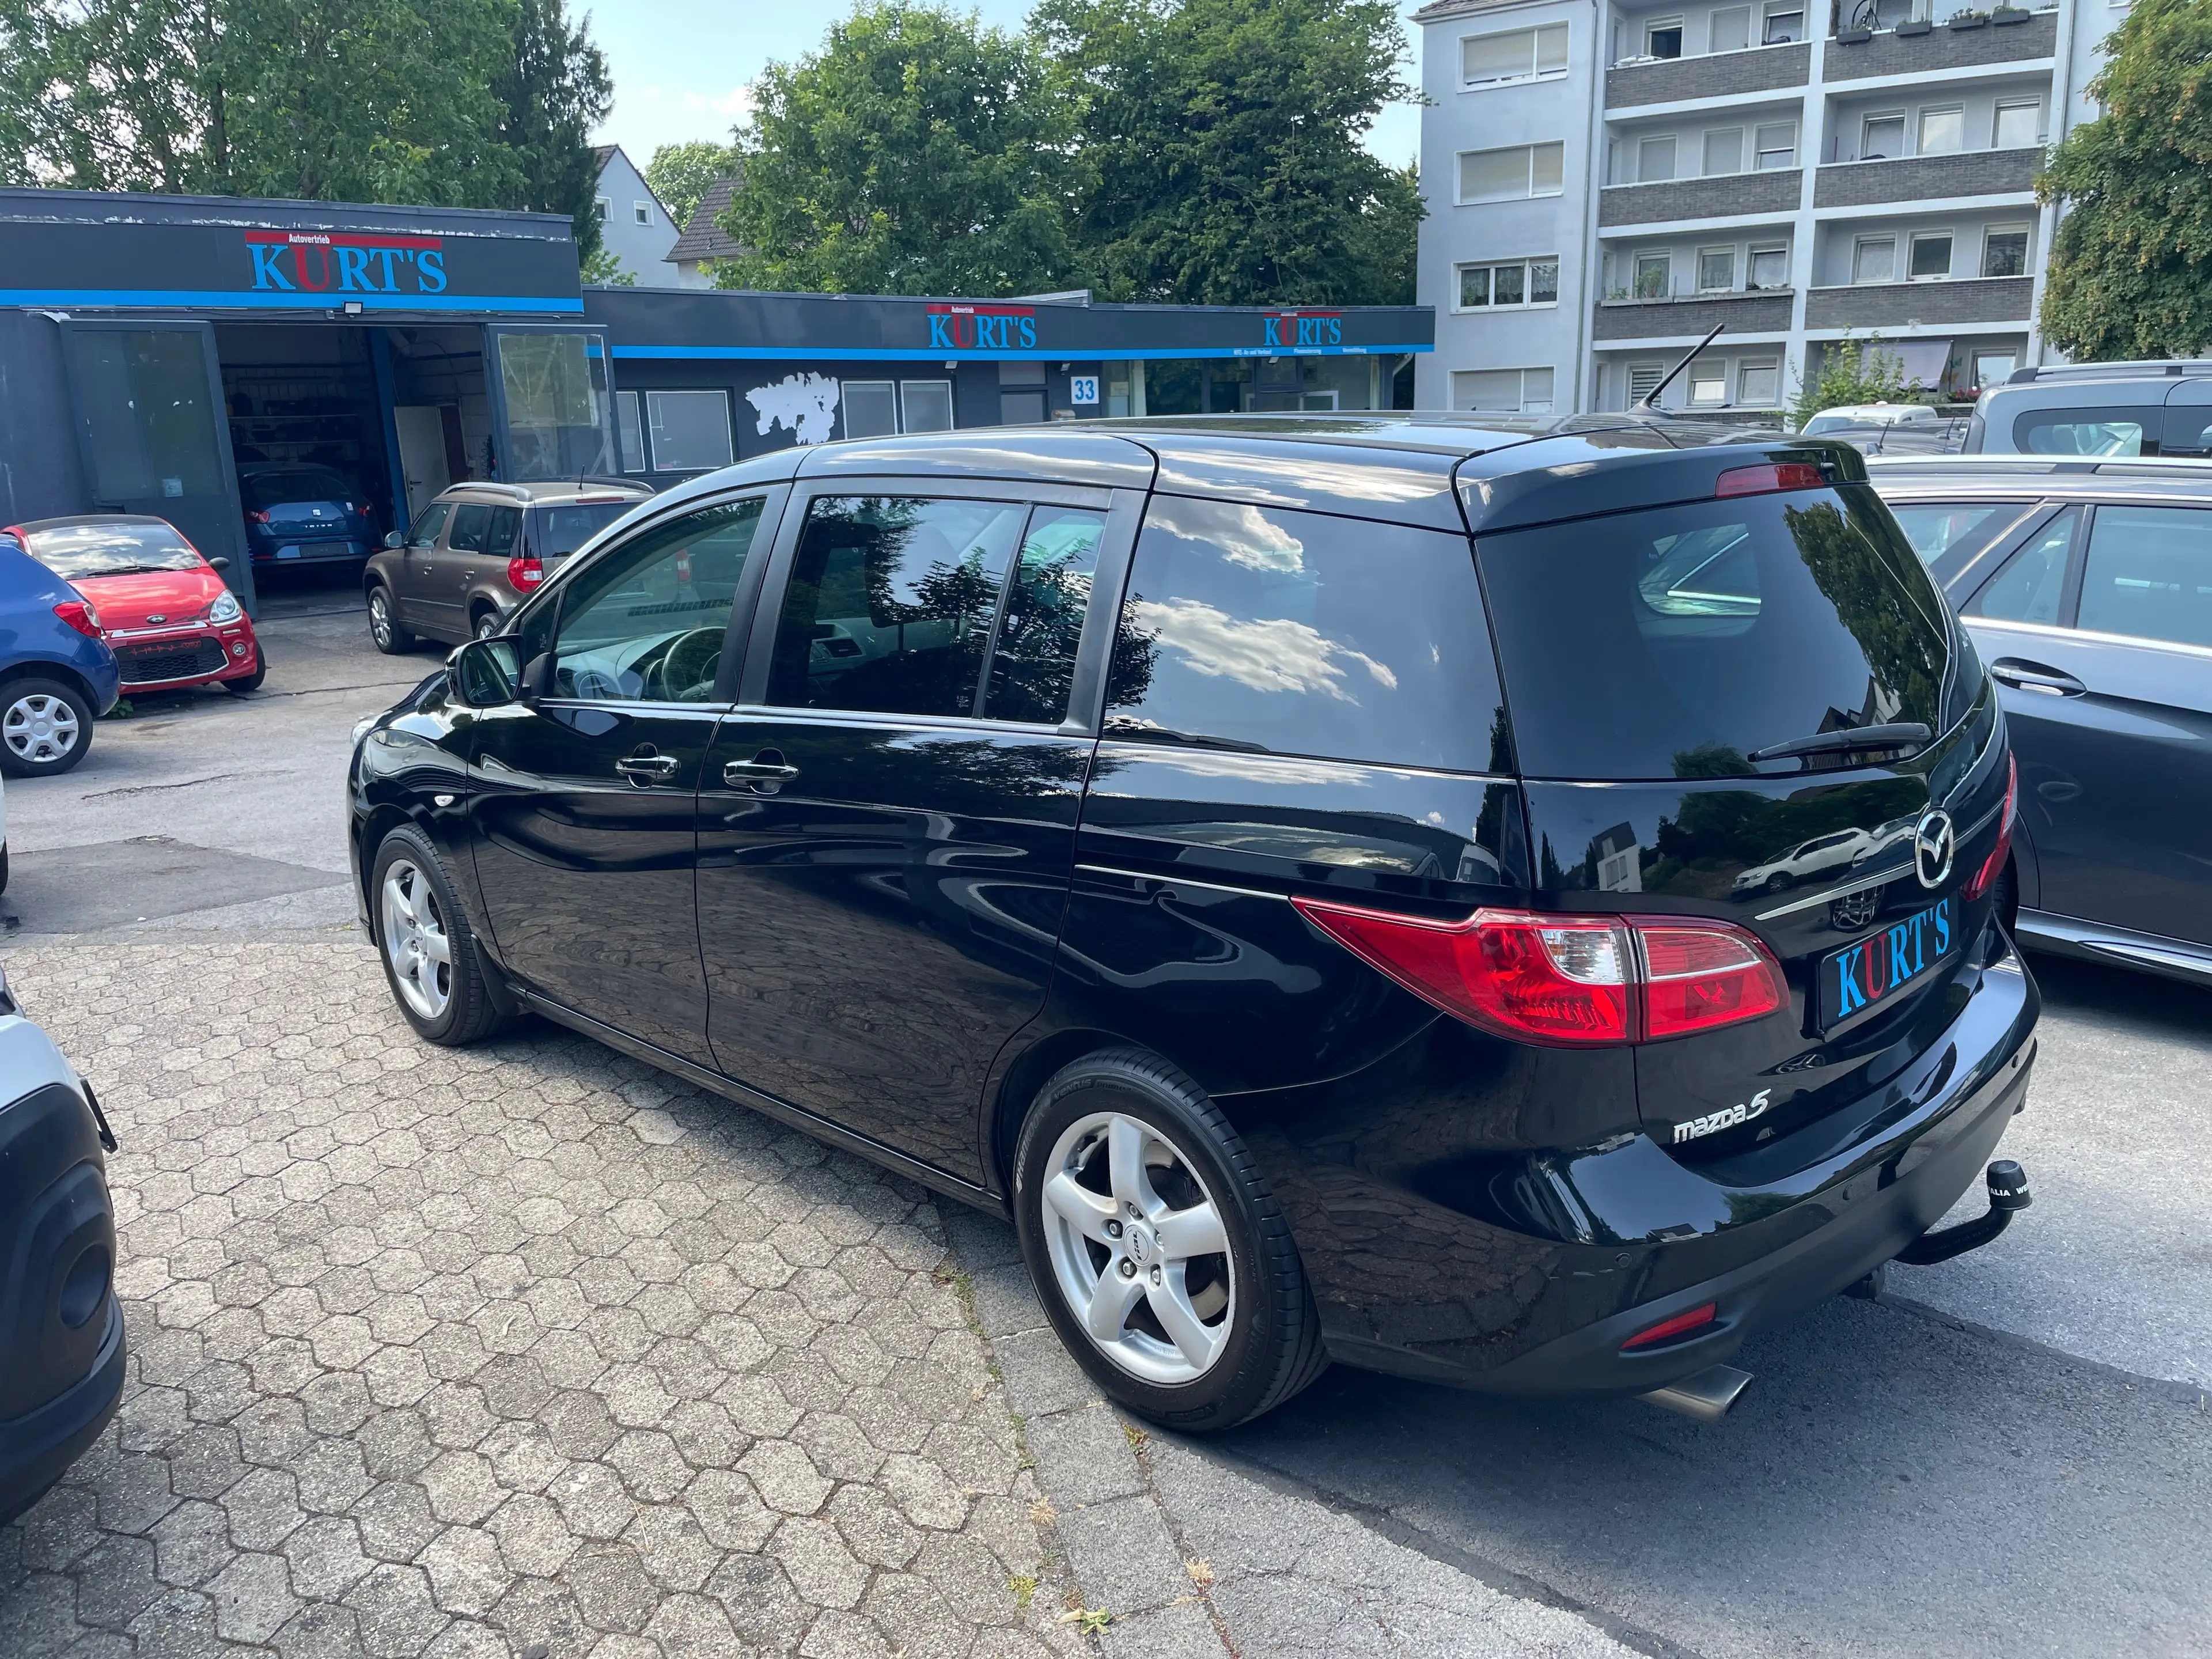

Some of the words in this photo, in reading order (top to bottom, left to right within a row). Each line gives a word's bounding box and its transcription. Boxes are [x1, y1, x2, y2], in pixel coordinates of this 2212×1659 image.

[289, 233, 330, 244] Autovertrieb
[247, 244, 447, 293] KURT'S
[927, 315, 1037, 348] KURT'S
[1264, 318, 1342, 346] KURT'S
[1074, 380, 1095, 400] 33
[1836, 897, 1949, 1018] KURT'S
